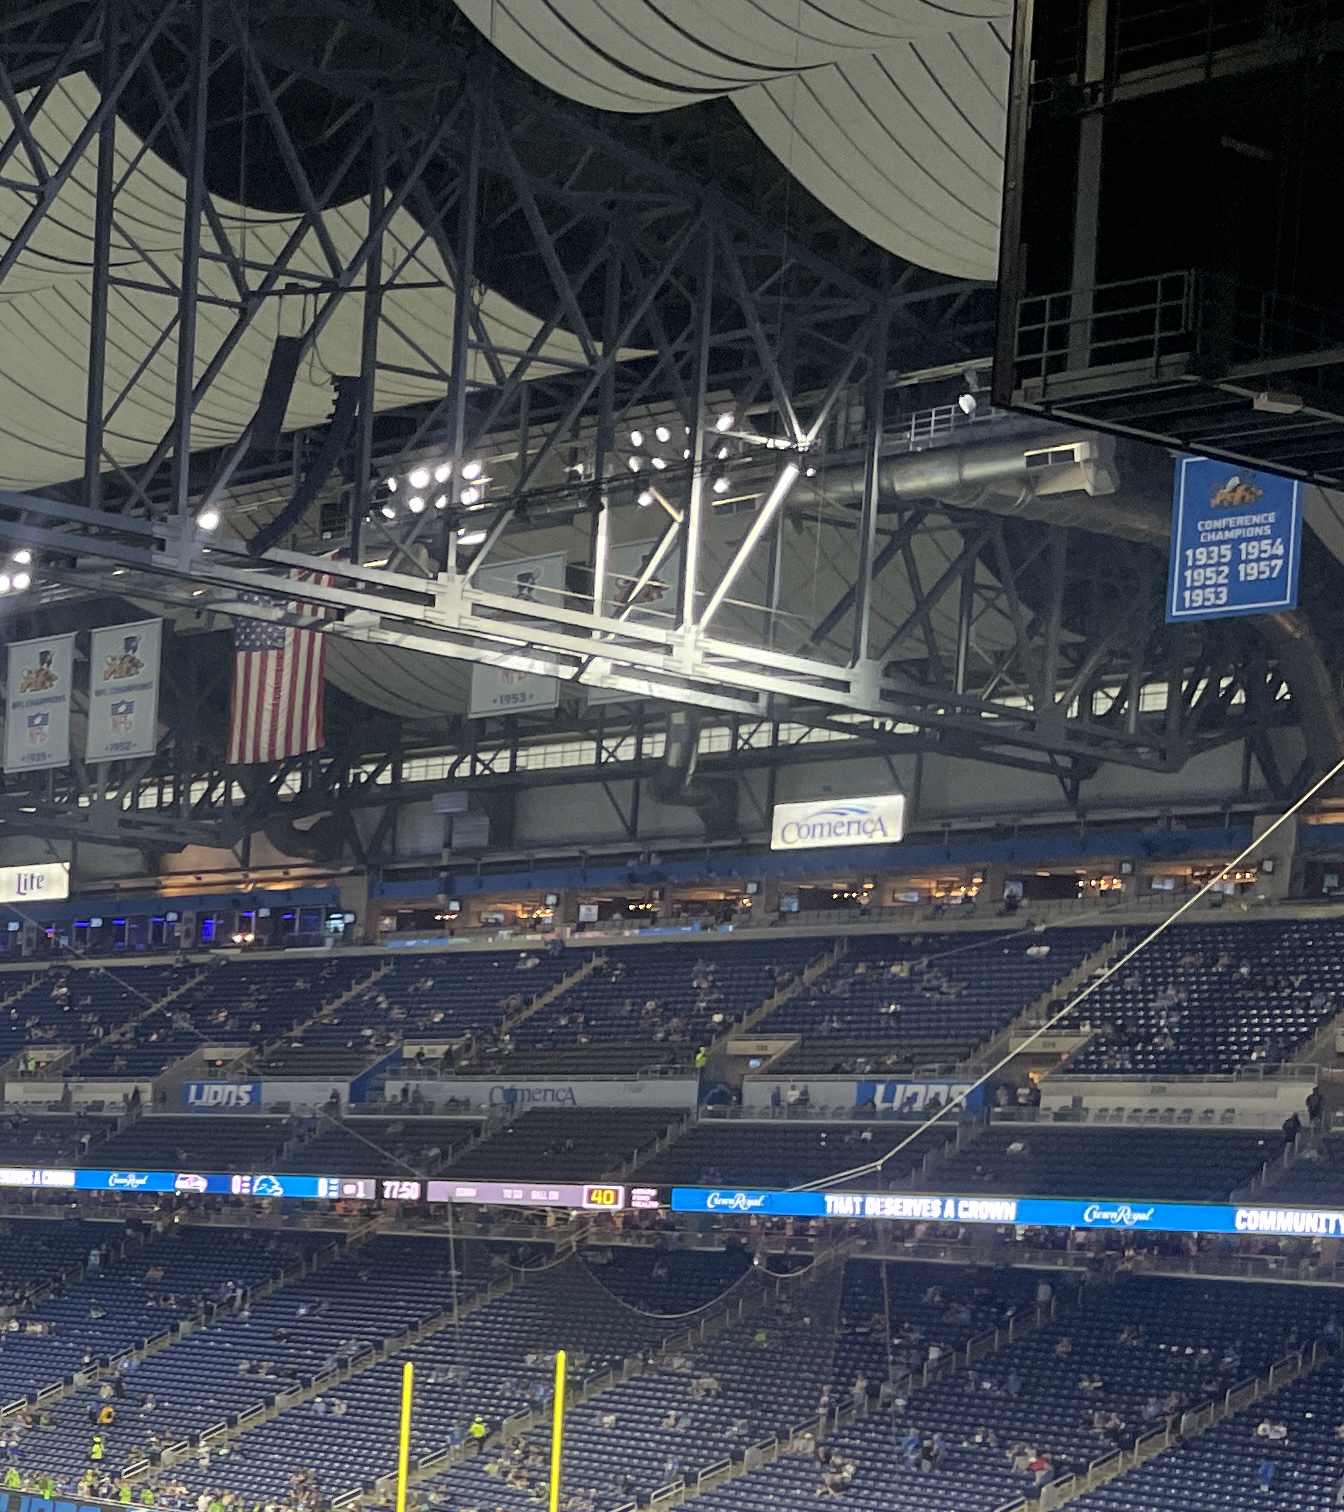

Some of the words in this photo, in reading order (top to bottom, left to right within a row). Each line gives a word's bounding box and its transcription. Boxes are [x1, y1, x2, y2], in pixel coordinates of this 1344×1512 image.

[1197, 512, 1276, 531] CONFERENCE
[1200, 525, 1272, 542] CHAMPIONS
[1185, 544, 1232, 567] 1935
[1238, 538, 1284, 561] 1954
[1183, 565, 1229, 588] 1952
[1239, 559, 1283, 582] 1957
[1183, 586, 1228, 609] 1953
[16, 872, 45, 896] Lite
[189, 1084, 253, 1107] LIONS
[590, 1189, 615, 1205] 40
[825, 1194, 863, 1216] THAT
[865, 1196, 942, 1219] DESERVES
[943, 1199, 958, 1220] A
[958, 1199, 1017, 1221] CROWN
